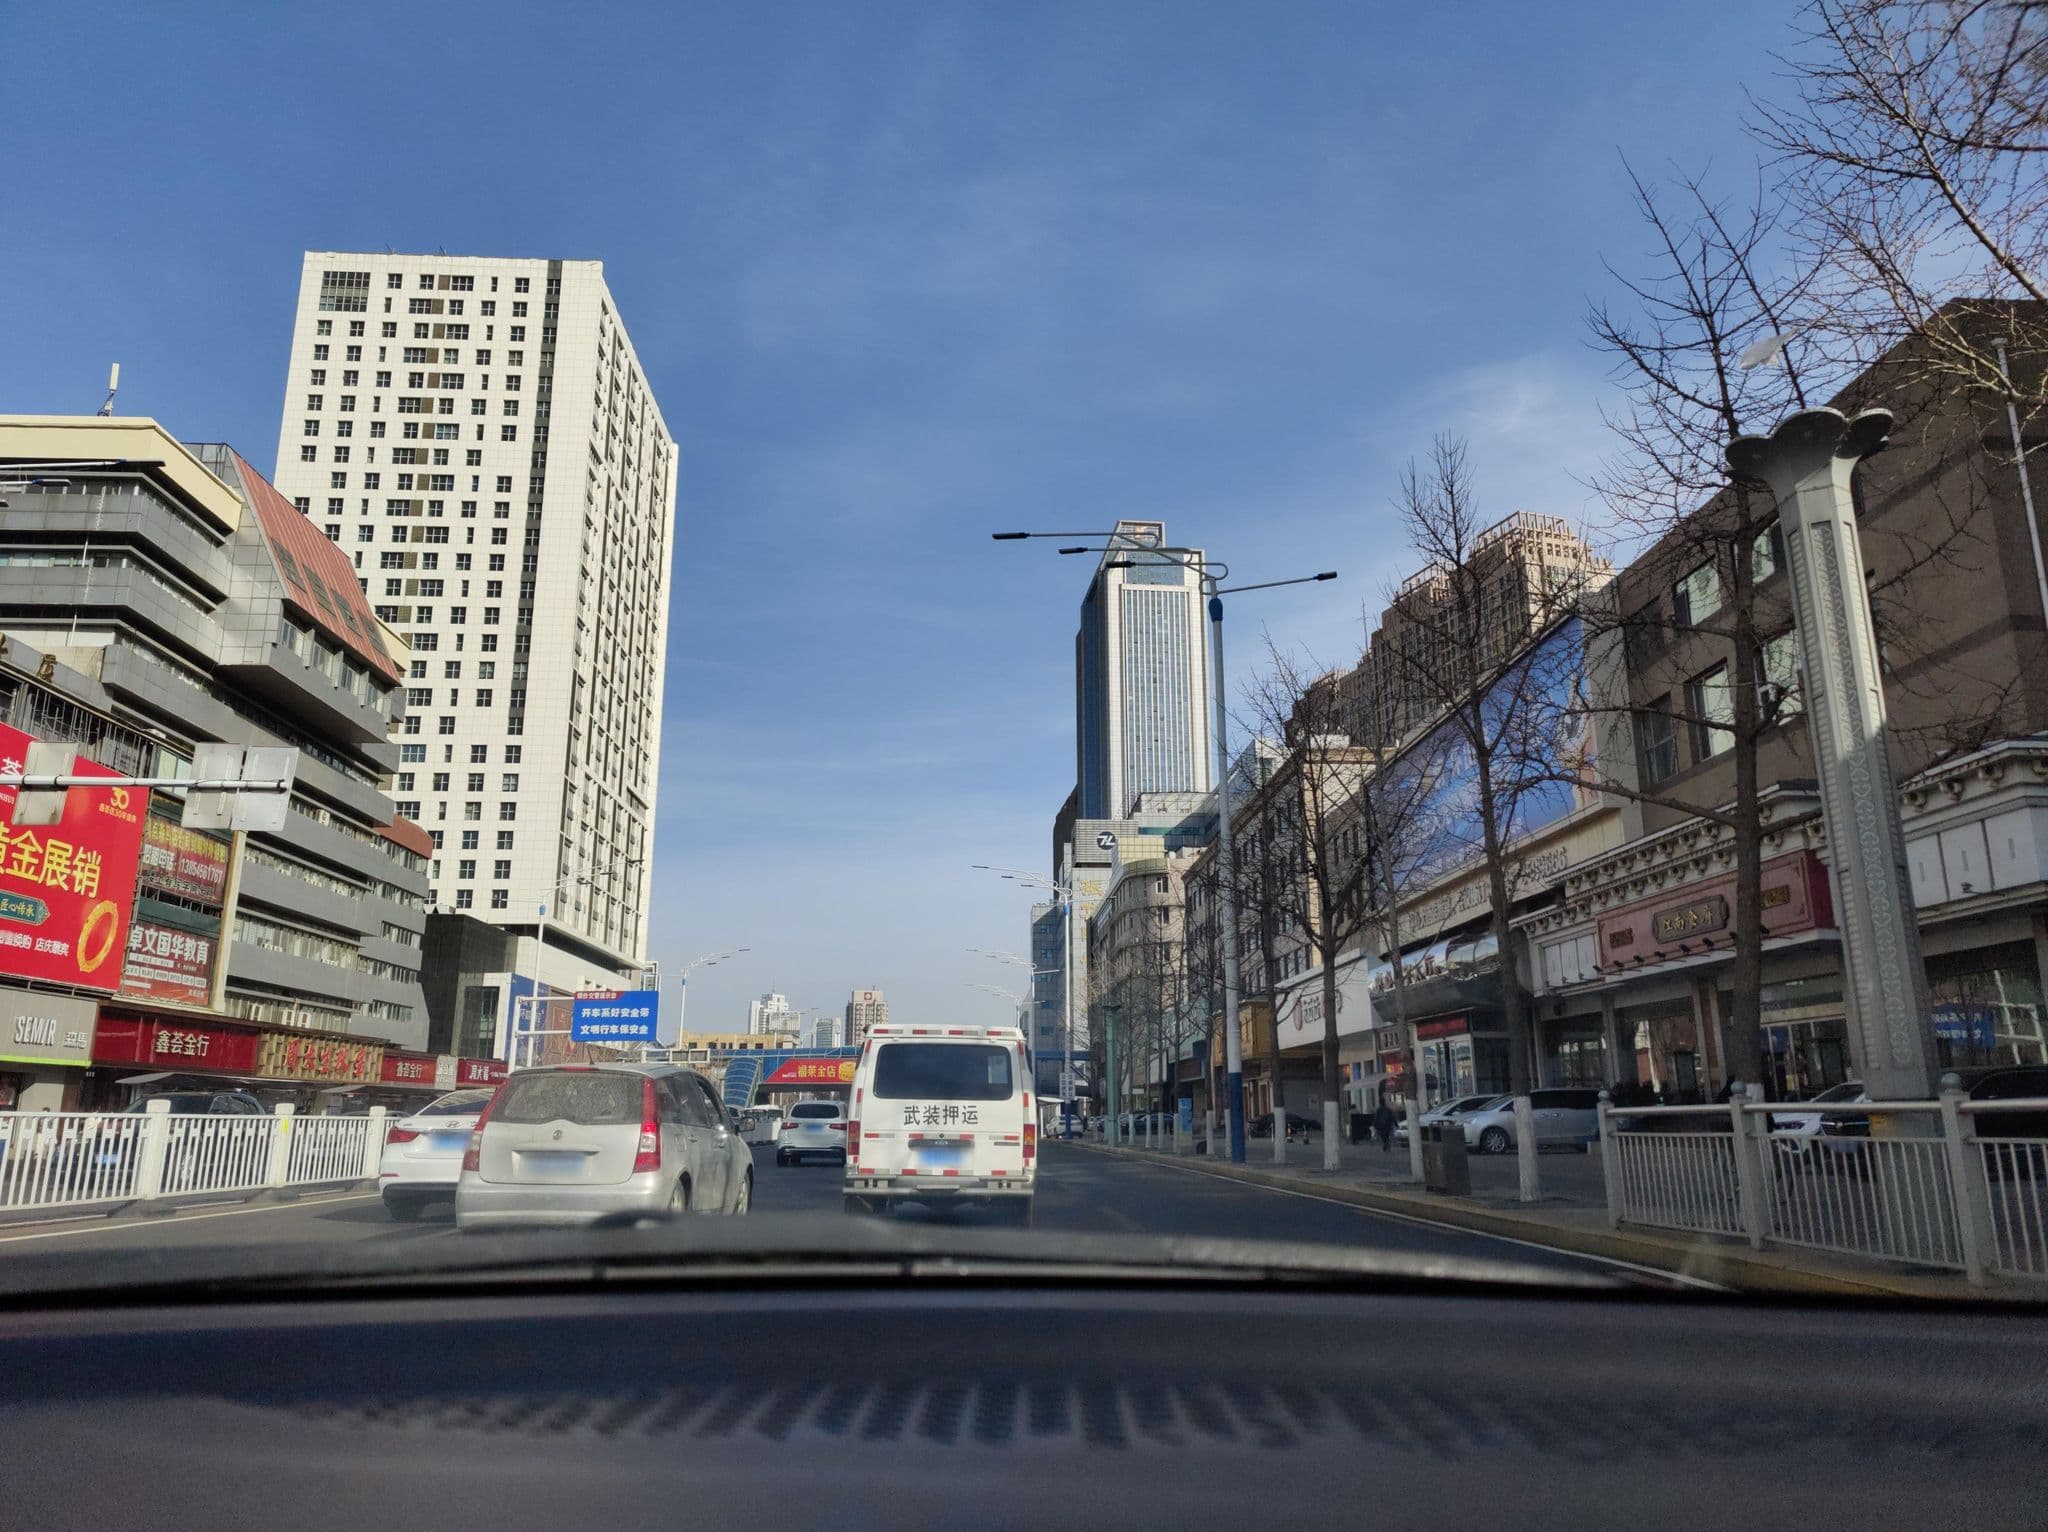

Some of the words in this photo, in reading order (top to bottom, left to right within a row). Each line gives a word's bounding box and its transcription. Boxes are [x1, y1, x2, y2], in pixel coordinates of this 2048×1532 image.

[129, 924, 209, 965] 卓文国华教育
[581, 1007, 650, 1018] 开车系好安全带
[15, 1016, 57, 1046] SEMIR
[580, 1025, 649, 1035] 文明行车保安全
[155, 1030, 210, 1057] 鑫荟金行
[396, 1061, 422, 1078] 鑫荟金行
[798, 1065, 837, 1078] 福莱金店
[903, 1105, 979, 1126] 武装押运
